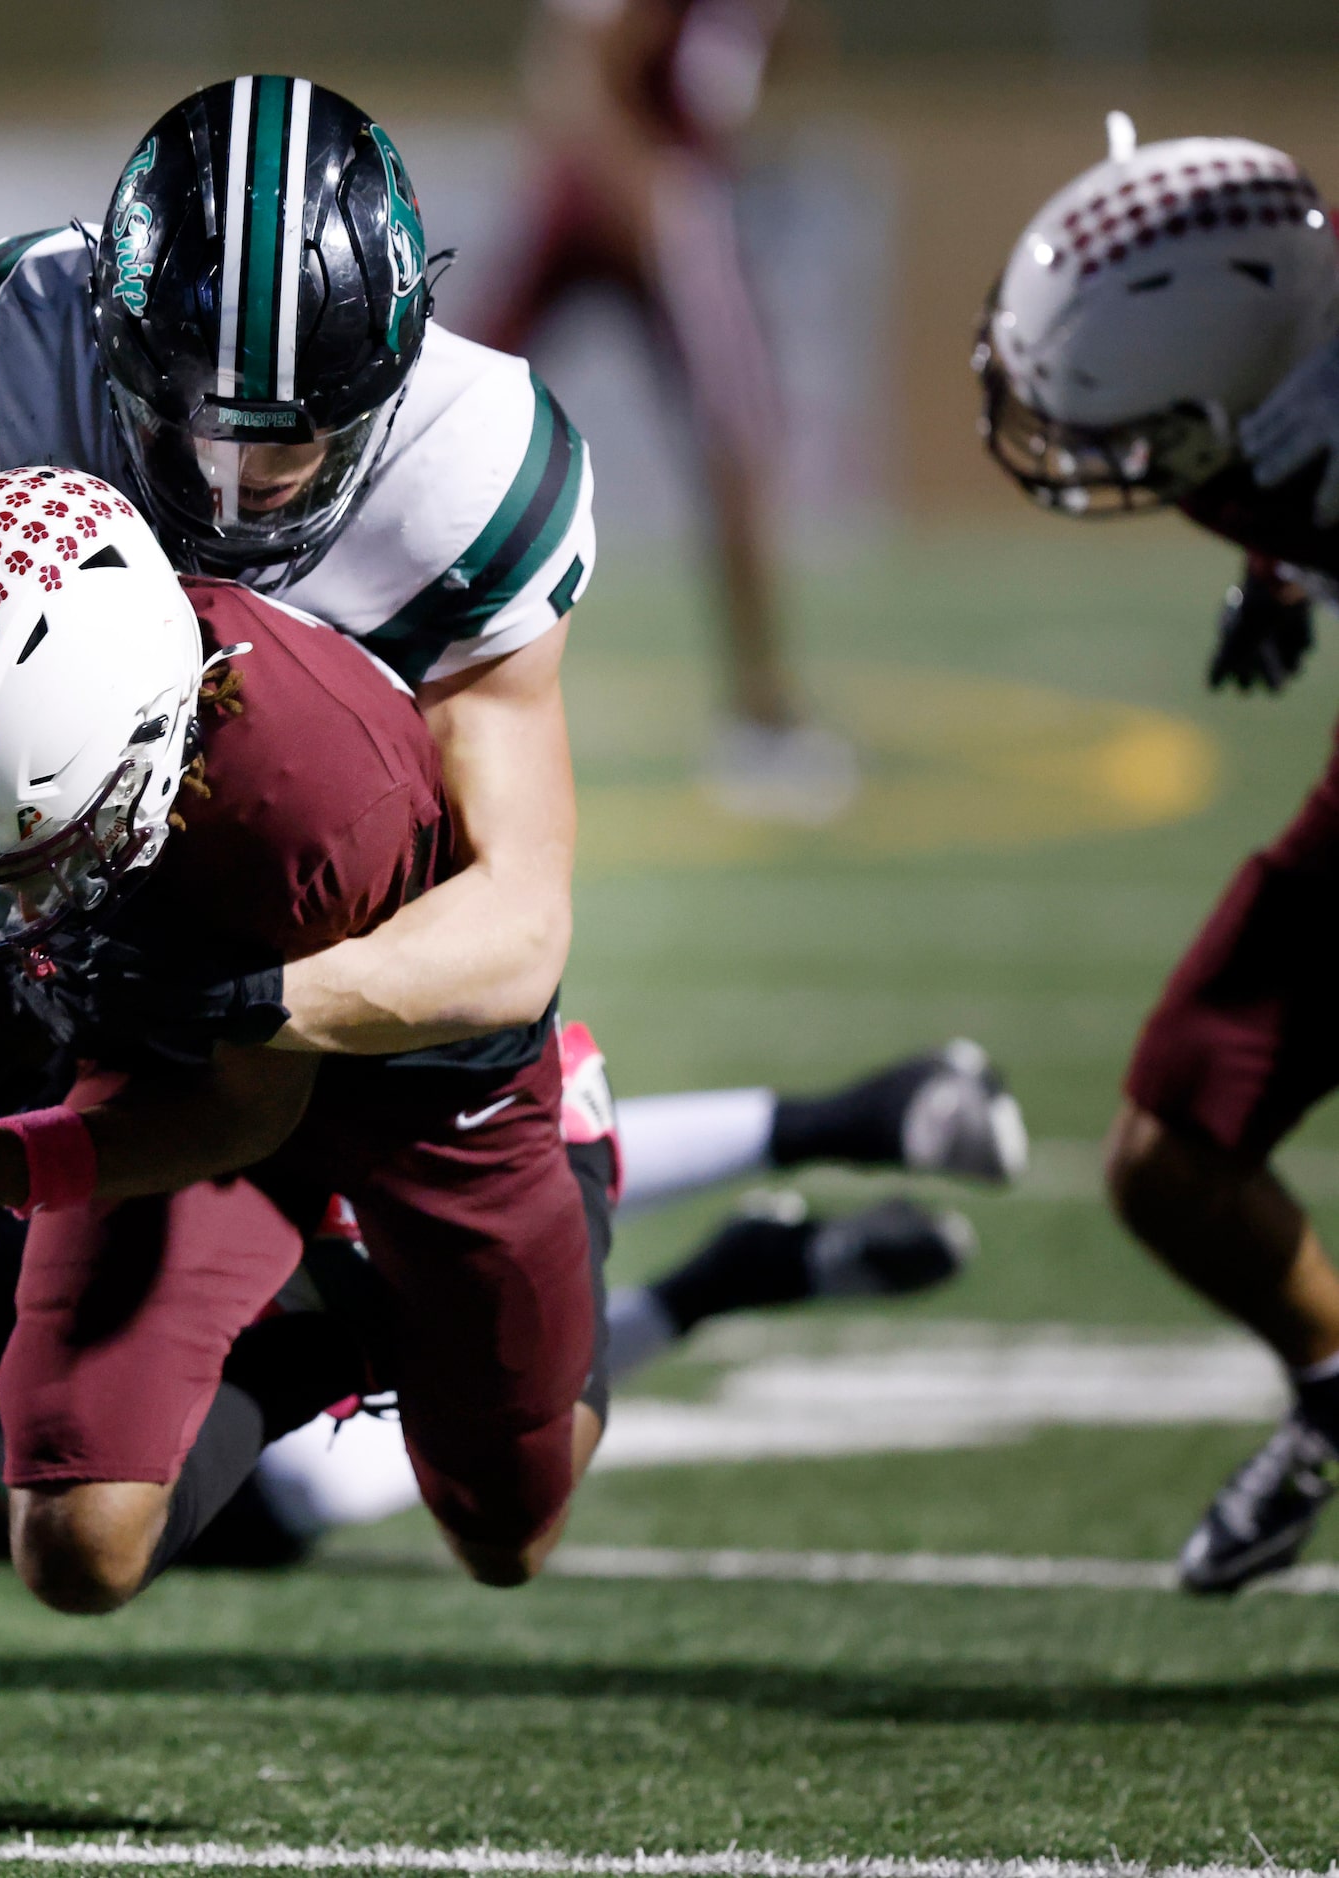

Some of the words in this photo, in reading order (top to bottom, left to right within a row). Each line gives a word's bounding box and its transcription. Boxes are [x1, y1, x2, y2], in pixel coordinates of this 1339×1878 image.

[116, 136, 157, 212] The
[112, 202, 154, 317] Ship
[218, 407, 297, 427] PROSPER
